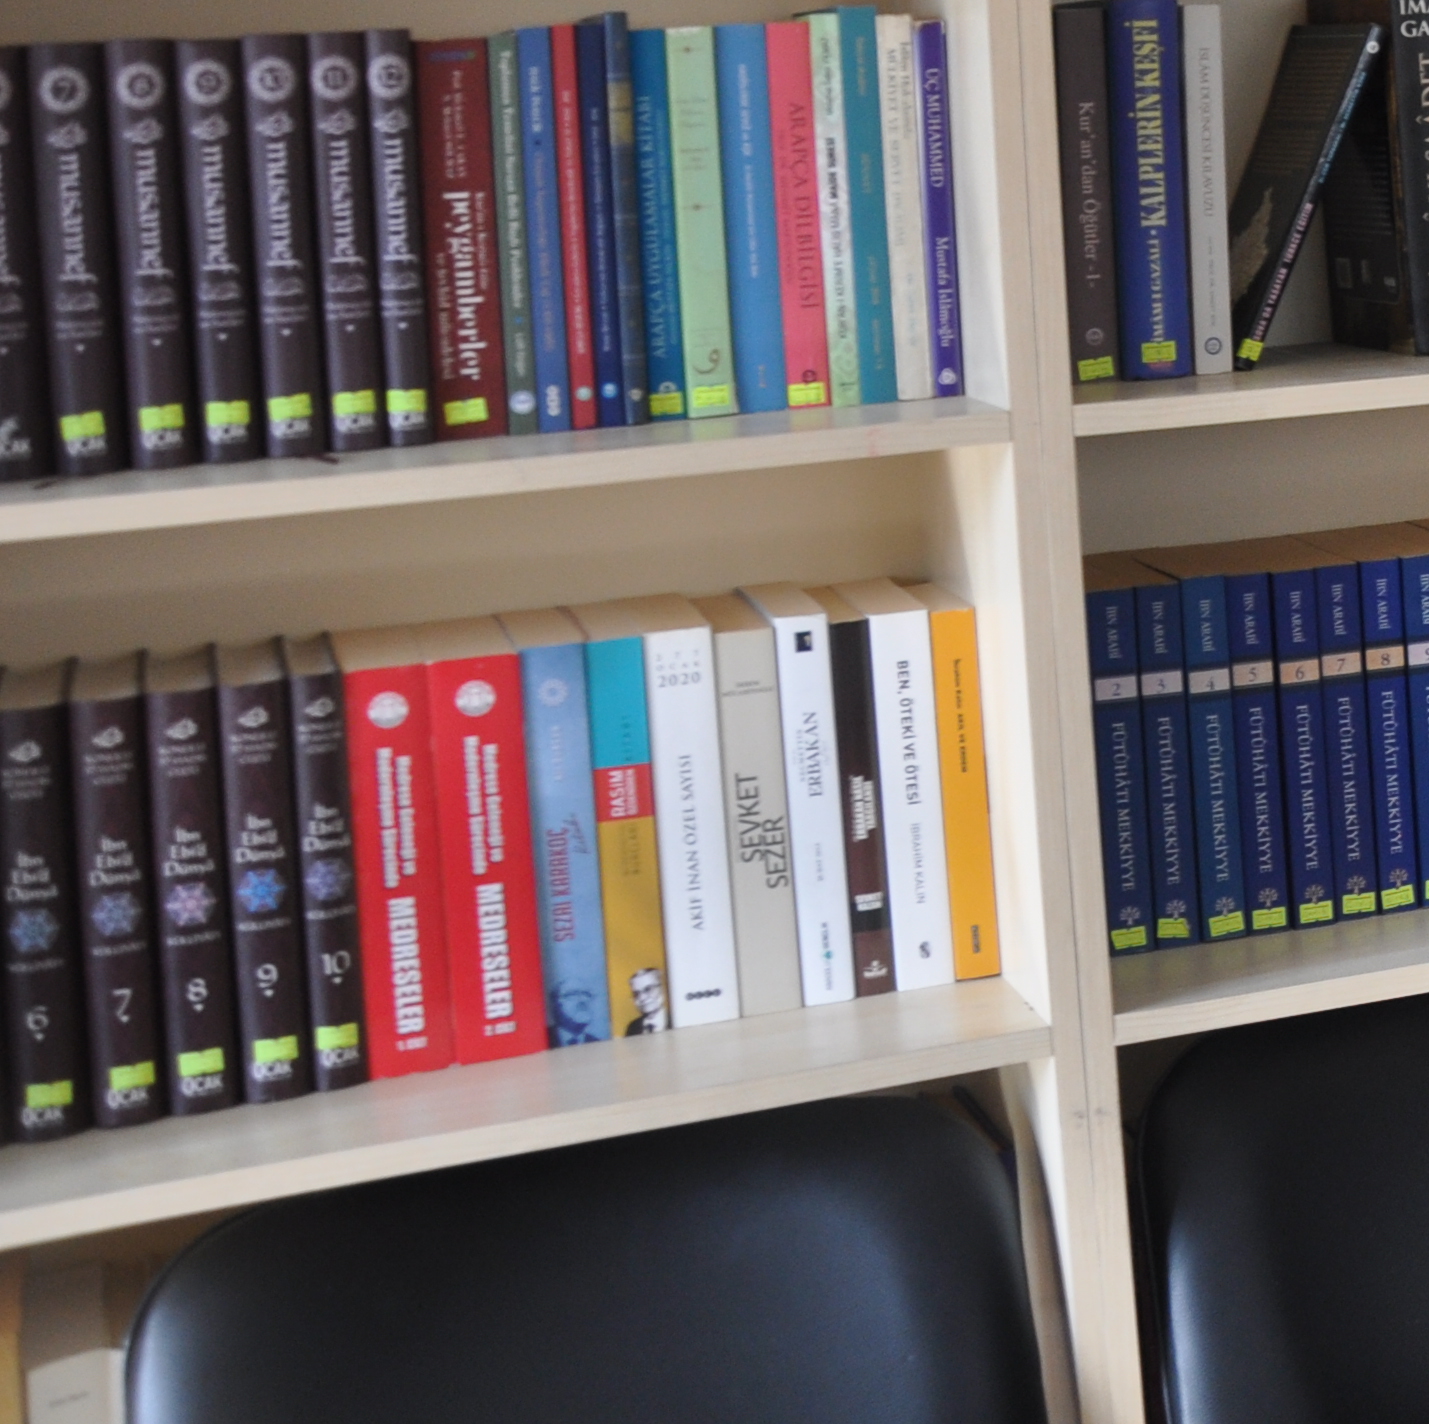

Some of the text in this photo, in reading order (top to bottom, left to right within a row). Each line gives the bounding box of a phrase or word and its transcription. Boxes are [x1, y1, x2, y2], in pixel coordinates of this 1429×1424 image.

[926, 93, 944, 188] MUHAMMED
[658, 671, 702, 689] 2020
[1295, 665, 1305, 680] 6
[1111, 683, 1121, 696] 2
[802, 711, 824, 798] ERBAKAN
[902, 743, 918, 761] VE
[766, 816, 789, 889] SEZER
[321, 951, 349, 975] 10
[476, 882, 514, 1020] MEDRESELER
[256, 963, 278, 988] 9
[388, 896, 425, 1035] MEDRESELER
[187, 978, 207, 1002] 8
[112, 988, 132, 1019] 7
[26, 1007, 48, 1031] 6
